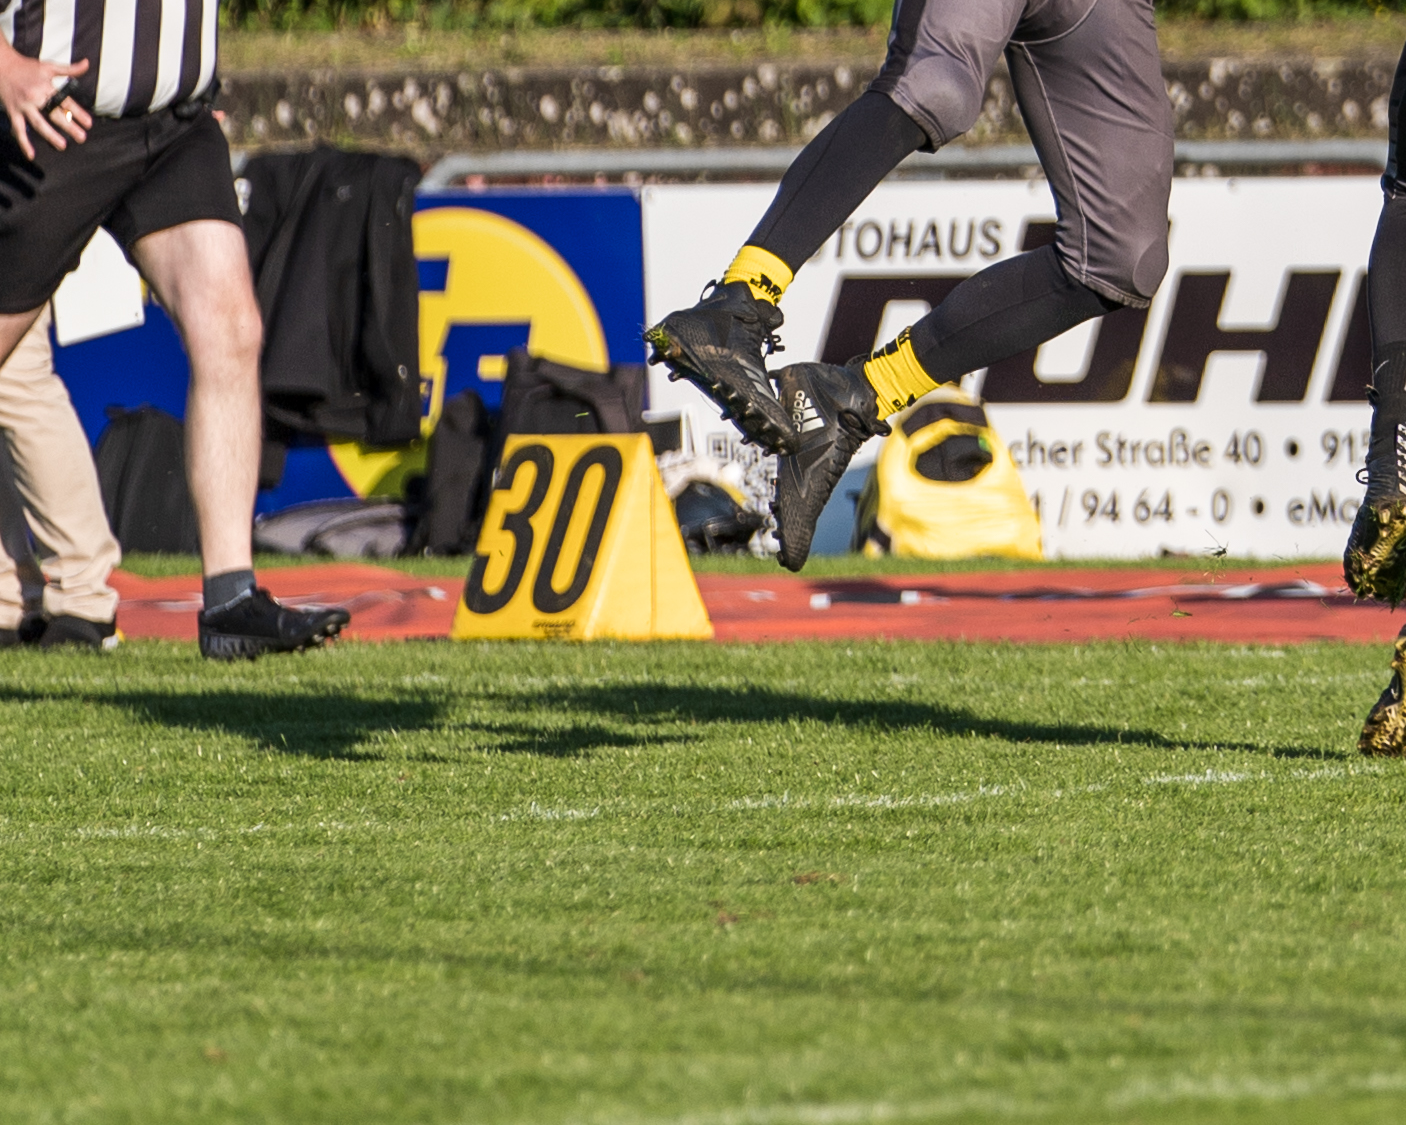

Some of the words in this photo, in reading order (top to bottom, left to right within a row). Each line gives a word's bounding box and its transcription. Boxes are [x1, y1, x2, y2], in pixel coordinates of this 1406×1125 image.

[812, 218, 1003, 262] TOHAUS
[1095, 427, 1213, 469] Straße
[1224, 430, 1264, 466] 40
[1081, 489, 1121, 523] 94
[1133, 487, 1174, 524] 64
[1211, 488, 1232, 524] 0
[464, 443, 624, 615] 30
